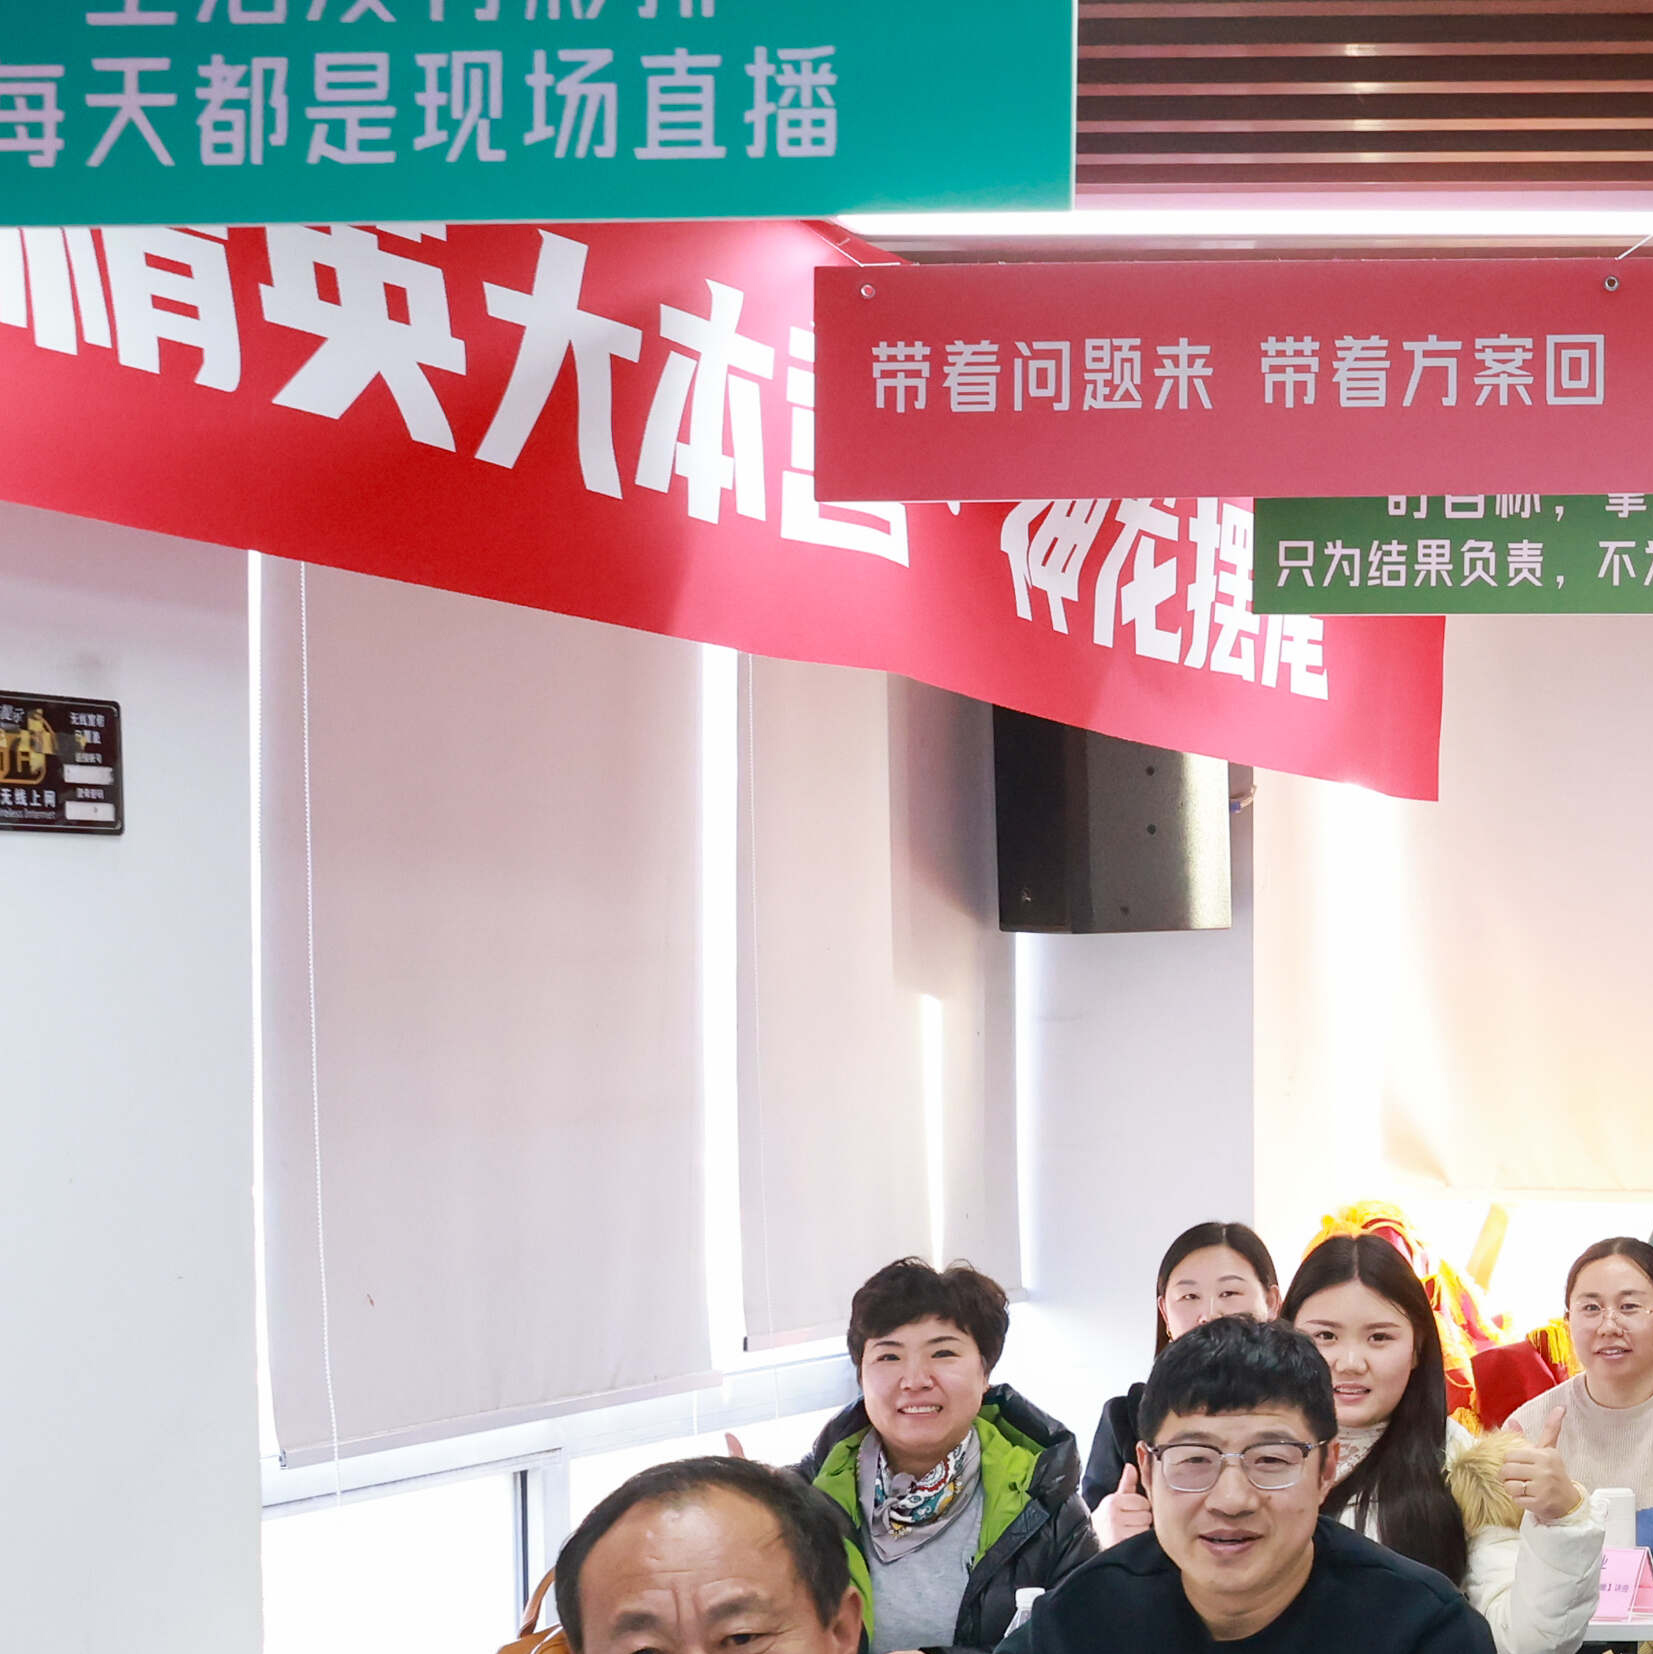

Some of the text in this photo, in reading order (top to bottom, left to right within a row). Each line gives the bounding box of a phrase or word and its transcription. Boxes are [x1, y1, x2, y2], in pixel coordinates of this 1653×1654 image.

[0, 45, 838, 168] 每天都是现场直播
[871, 333, 1605, 414] 带着问题来 带着方案回
